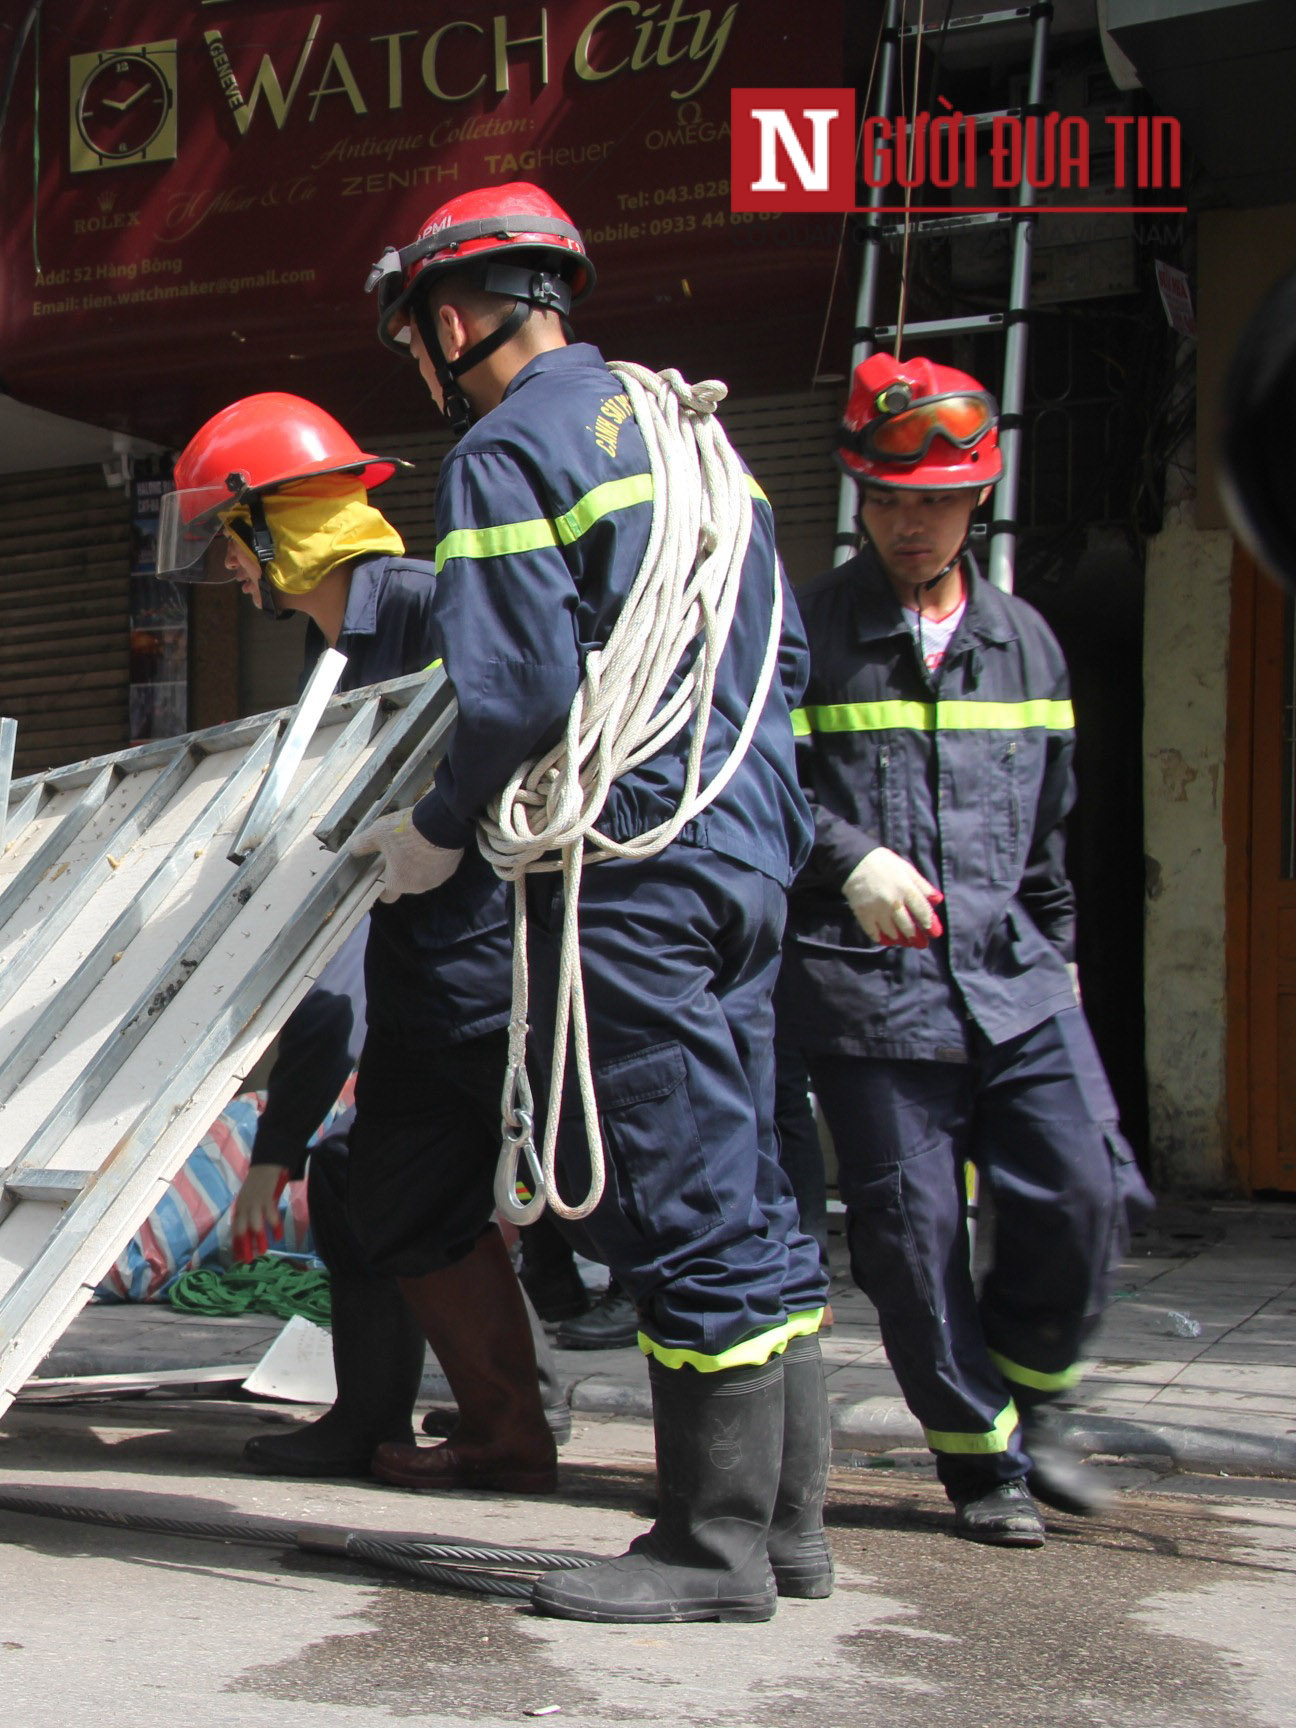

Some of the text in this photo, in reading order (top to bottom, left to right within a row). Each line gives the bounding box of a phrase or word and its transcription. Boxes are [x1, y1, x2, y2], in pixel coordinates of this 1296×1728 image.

[204, 0, 738, 134] WATCH City
[209, 37, 245, 112] GENEVE
[645, 122, 731, 150] OMEGA
[342, 162, 458, 196] ZENITH
[617, 191, 649, 211] Tel:
[74, 211, 141, 234] ROLEX
[649, 216, 695, 236] 0933
[702, 211, 724, 229] 44
[73, 267, 92, 282] 52
[33, 269, 316, 316] Email: tien.watchmaker@gmail.com
